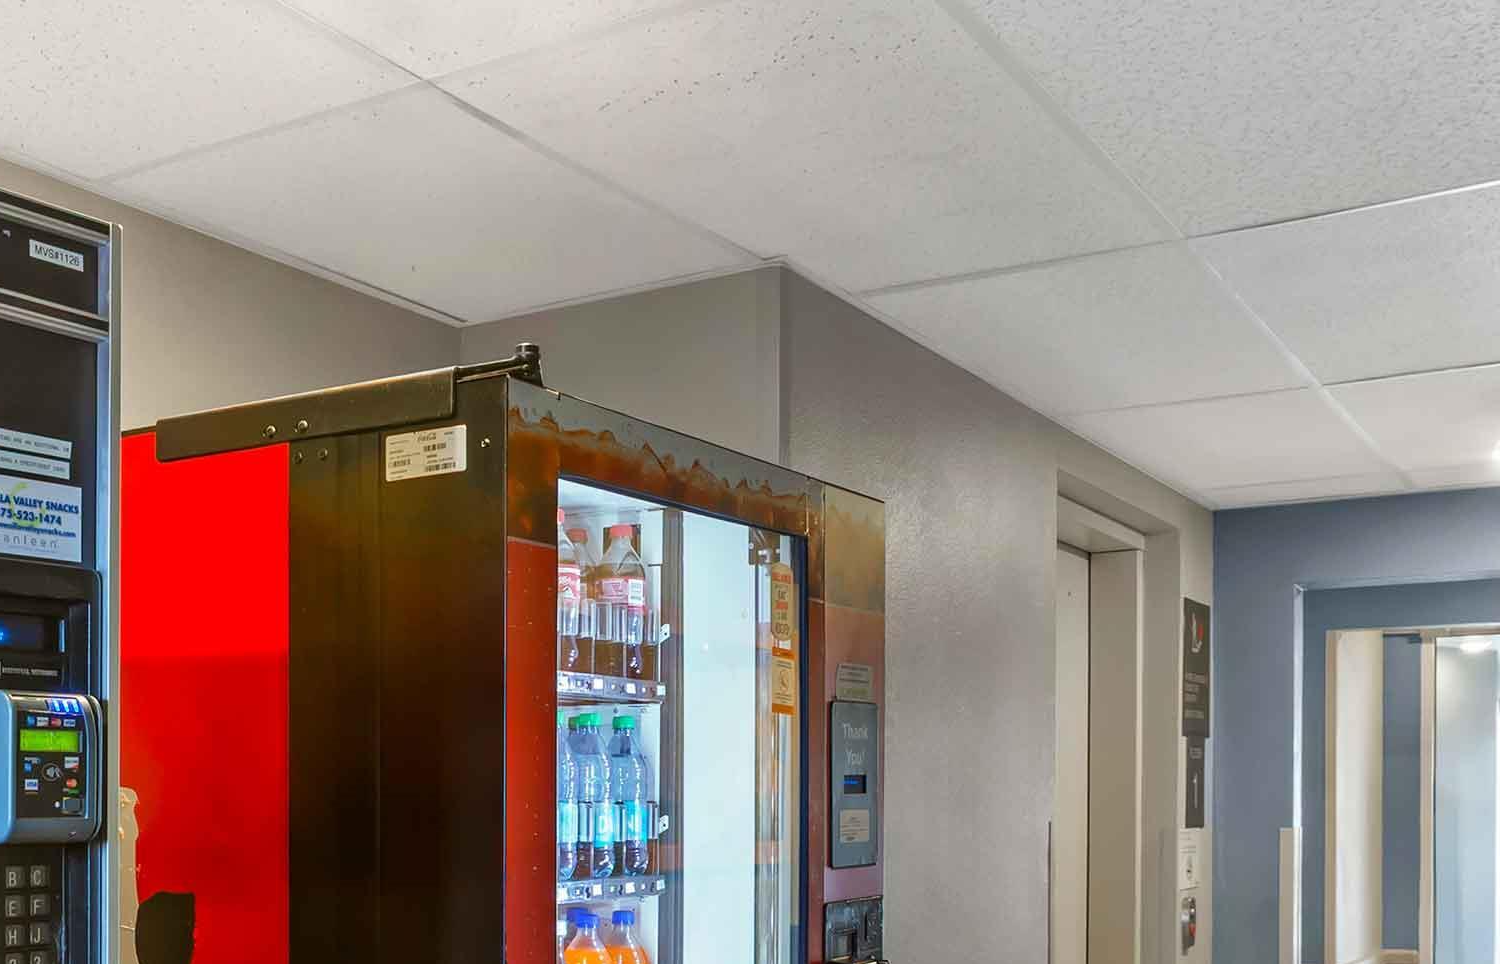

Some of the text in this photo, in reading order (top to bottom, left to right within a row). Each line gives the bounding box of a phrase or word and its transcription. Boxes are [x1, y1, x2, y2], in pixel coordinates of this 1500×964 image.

[13, 495, 44, 509] VALLEY
[45, 500, 79, 515] SNACKS
[843, 722, 868, 740] Thank
